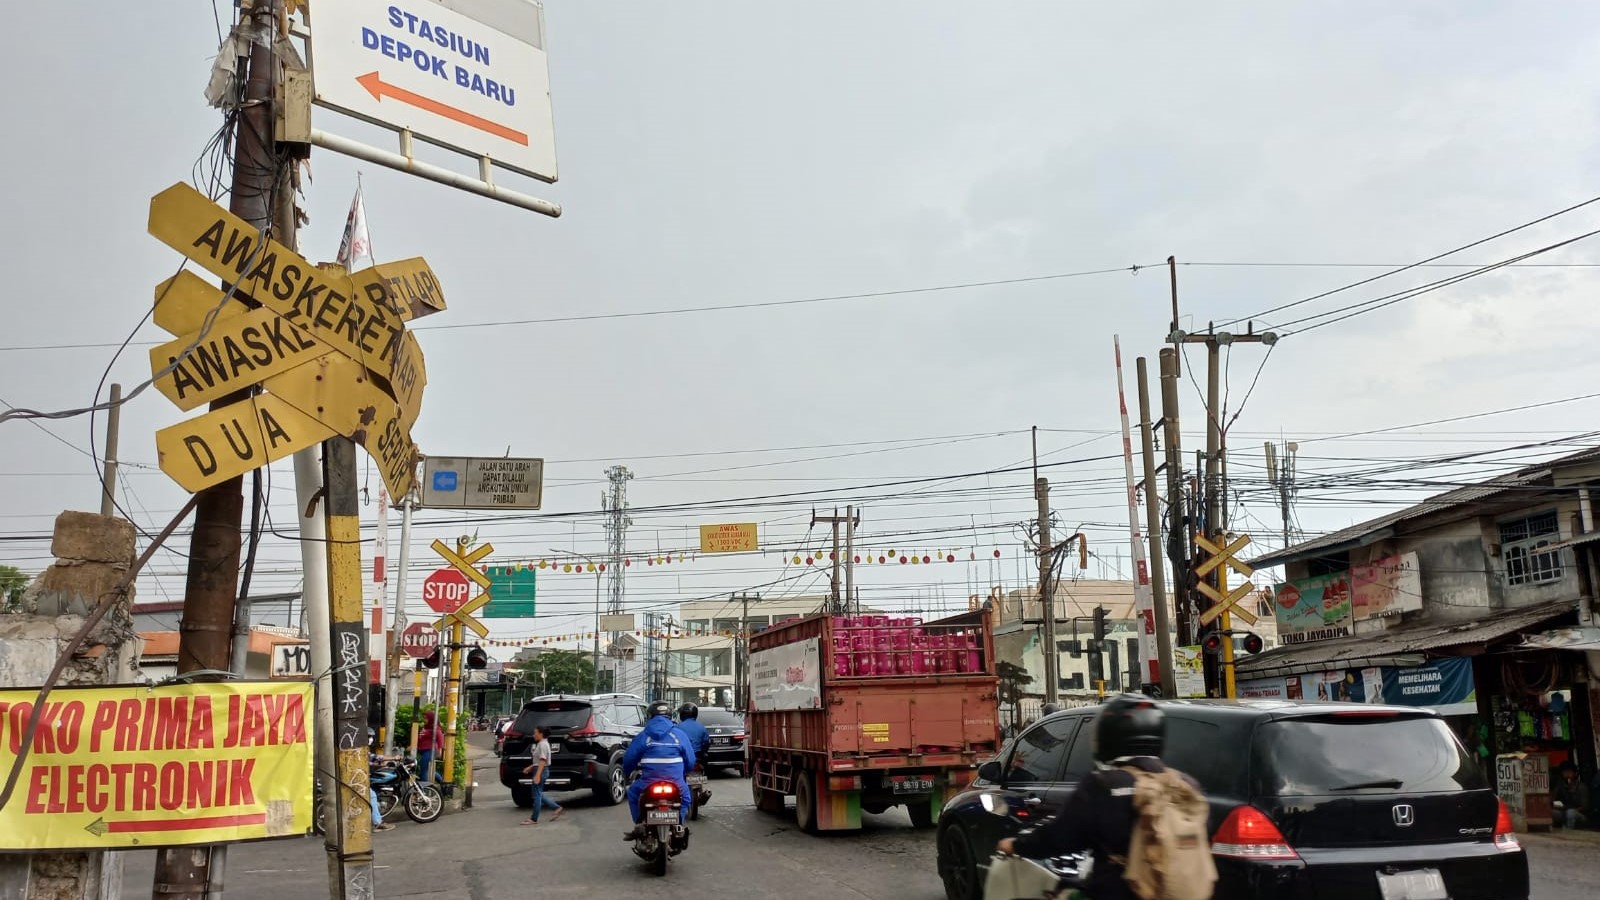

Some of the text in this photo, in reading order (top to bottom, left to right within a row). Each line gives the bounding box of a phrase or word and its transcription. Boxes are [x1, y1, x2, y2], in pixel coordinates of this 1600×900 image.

[388, 6, 490, 66] STASIUN
[361, 27, 515, 106] DEPOK BARU
[184, 408, 291, 477] DUA
[479, 462, 531, 471] JALAN SATU ARAH
[483, 472, 525, 482] DAPAT DILALUI
[477, 483, 529, 493] ANGKUTAN UMUM
[493, 494, 516, 504] PRIBADI
[425, 582, 468, 600] STOP
[404, 634, 436, 646] STOP
[1281, 632, 1305, 643] TOKO
[1398, 672, 1442, 684] MEMELIHARA
[1402, 684, 1441, 695] KESEHATAN
[90, 695, 214, 752] PRIMA
[224, 694, 306, 748] JAYA
[1498, 764, 1520, 780] SOL
[25, 758, 256, 814] ELECTRONIK
